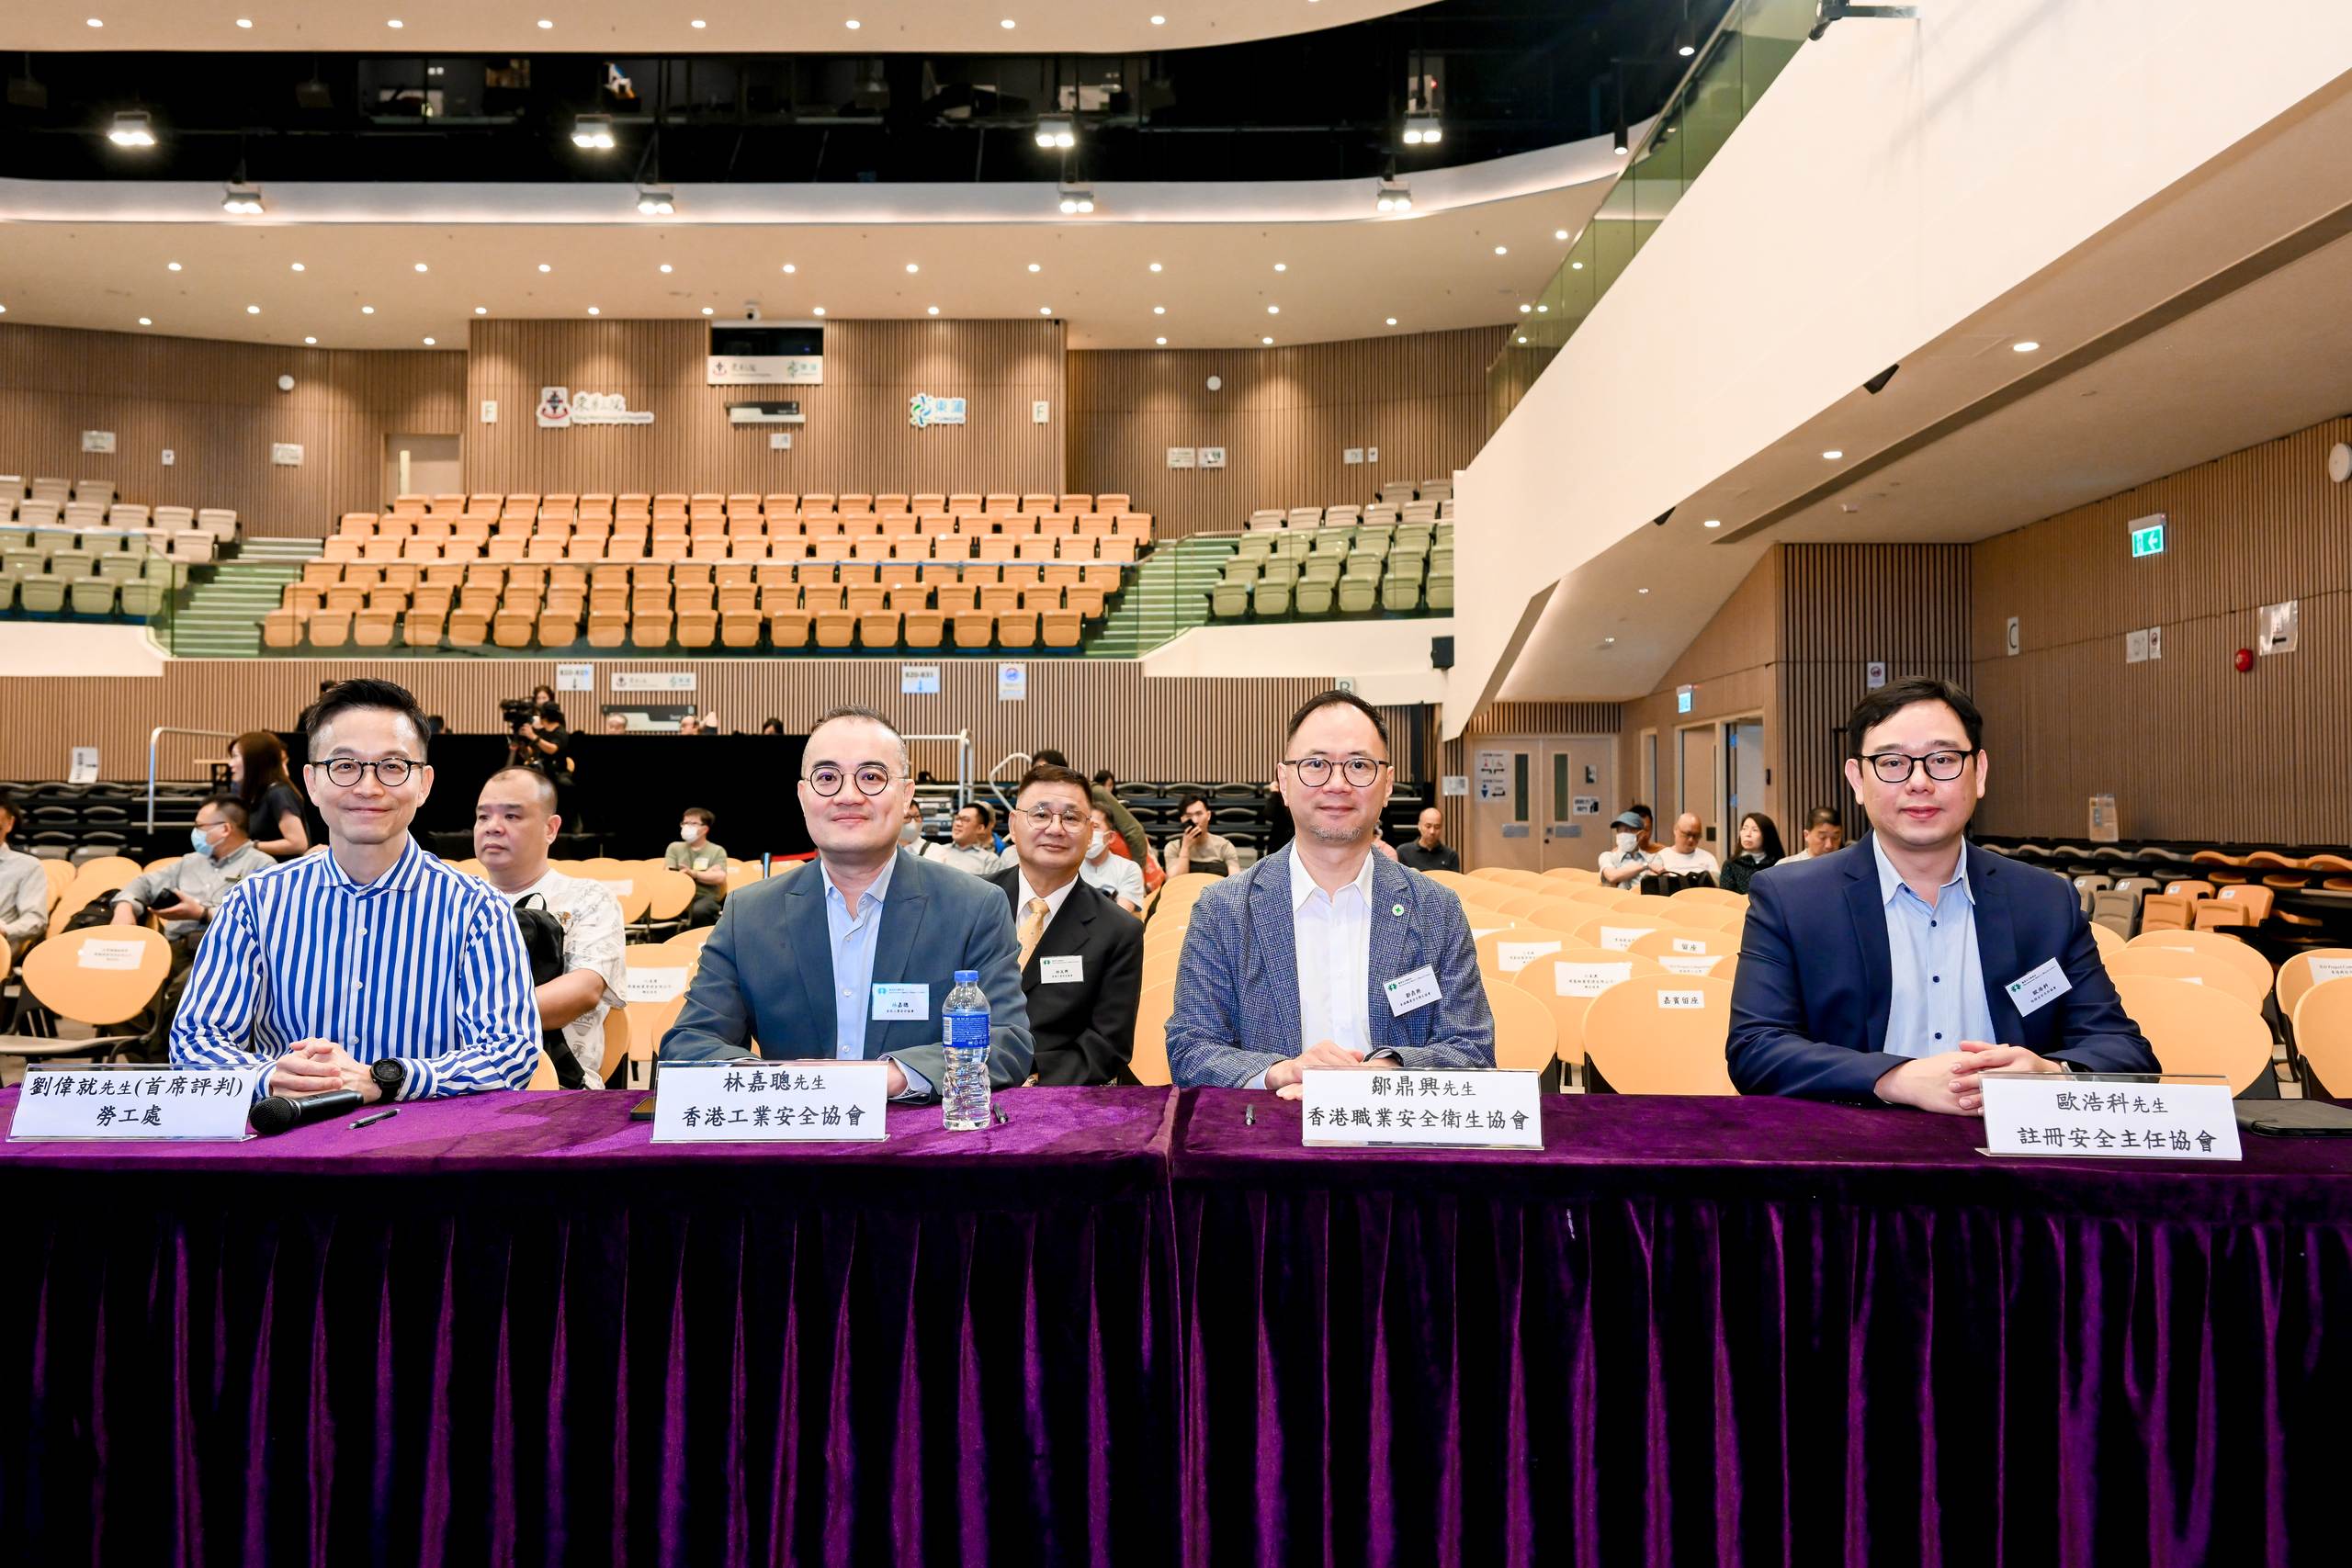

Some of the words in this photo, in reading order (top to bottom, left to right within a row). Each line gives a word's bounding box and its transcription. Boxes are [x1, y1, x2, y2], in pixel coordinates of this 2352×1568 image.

[1036, 404, 1045, 418] F
[1664, 996, 1699, 1005] 嘉賓留座
[723, 1070, 827, 1093] 林嘉聰先生
[1372, 1076, 1476, 1097] 鄒鼎興先生
[2056, 1091, 2169, 1114] 歐浩科先生
[96, 1104, 163, 1127] 勞工處
[682, 1104, 866, 1127] 香港工業安全協會
[1307, 1106, 1530, 1130] 香港職業安全衛生協會
[2017, 1127, 2217, 1152] 註冊安全主任協會
